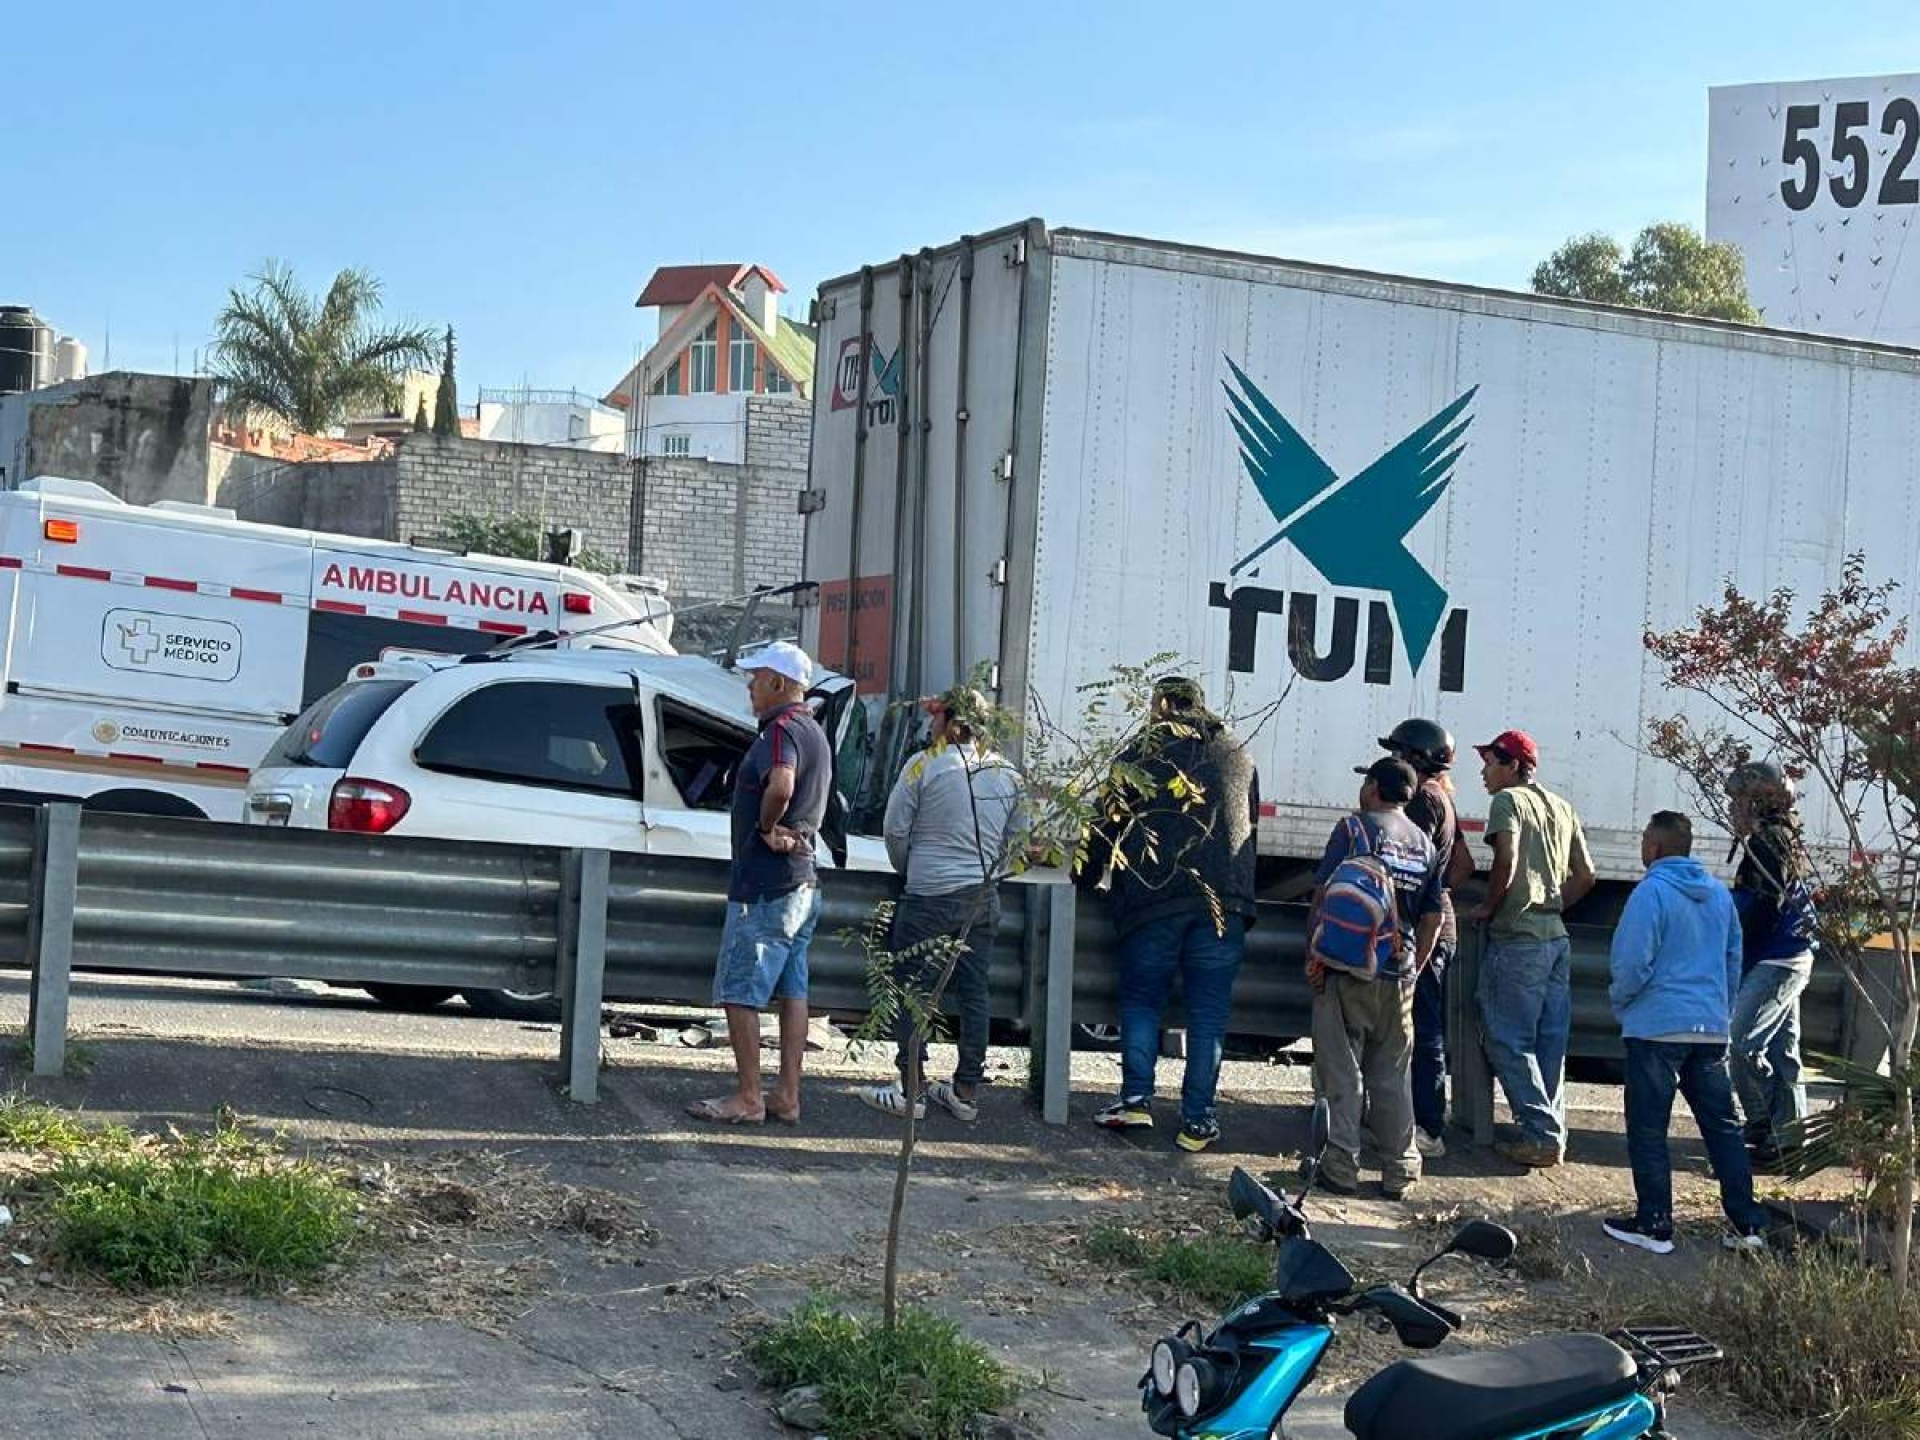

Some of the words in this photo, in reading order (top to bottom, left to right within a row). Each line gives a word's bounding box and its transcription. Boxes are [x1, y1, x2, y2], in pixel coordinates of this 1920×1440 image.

[1781, 97, 1919, 211] 552
[322, 563, 548, 614] AMBULANCIA
[165, 634, 231, 651] SERVICIO
[1208, 581, 1468, 692] TUM
[122, 726, 230, 747] COMUNICACIONES
